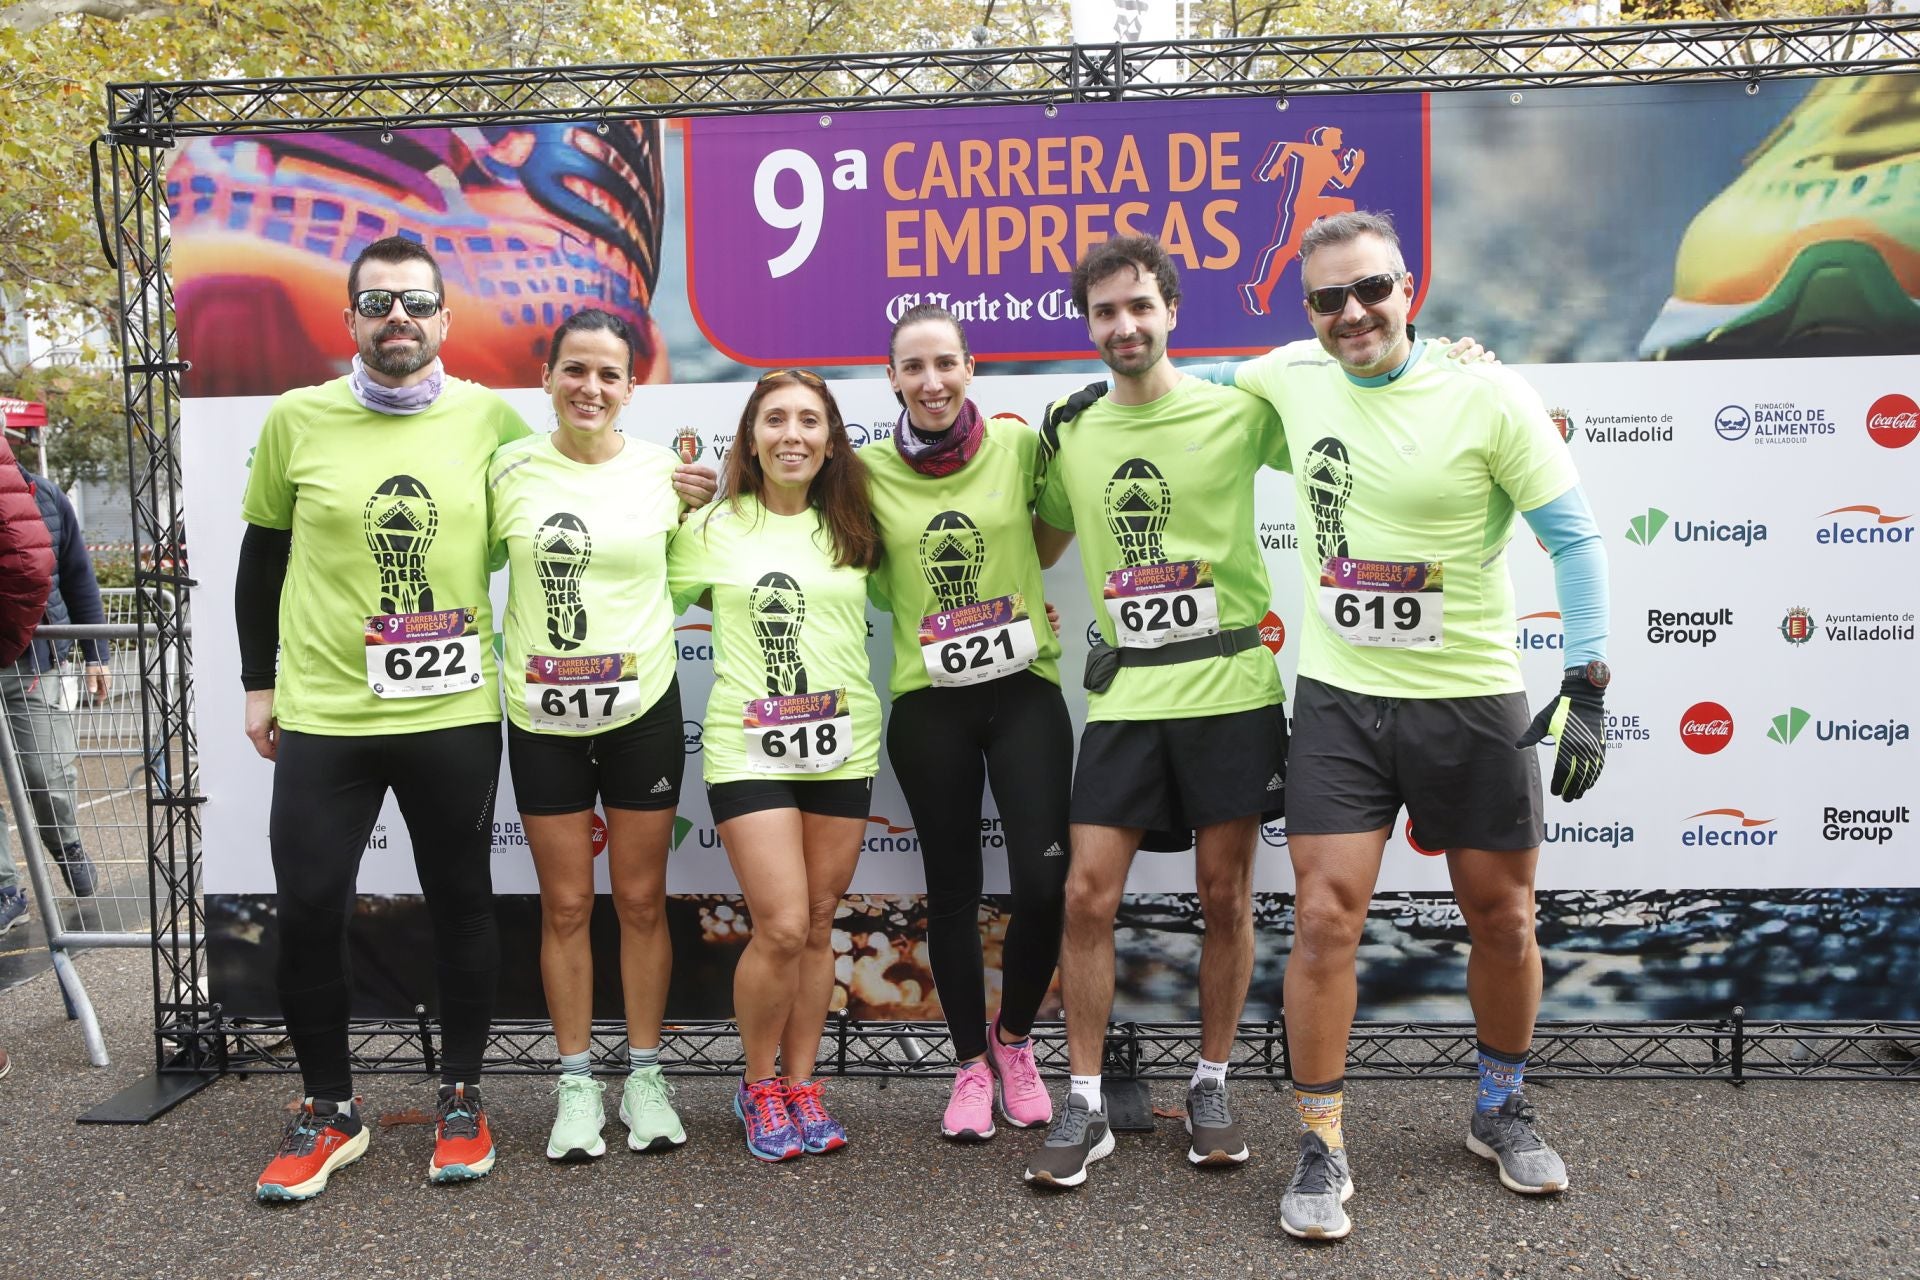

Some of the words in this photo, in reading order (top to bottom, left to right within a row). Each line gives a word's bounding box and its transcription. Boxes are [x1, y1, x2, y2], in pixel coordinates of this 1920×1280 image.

[883, 134, 1150, 201] CARRERA
[1168, 131, 1241, 192] DE
[886, 199, 1241, 277] EMPRESAS
[1004, 292, 1034, 322] de
[1585, 414, 1658, 426] Ayuntamiento
[1660, 413, 1673, 423] de
[1755, 410, 1802, 422] BANCO
[1806, 410, 1825, 420] DE
[1870, 412, 1920, 430] Coca-Cola
[1586, 426, 1673, 443] Valladolid
[1755, 423, 1836, 436] ALIMENTOS
[1323, 457, 1342, 486] MERLIN
[1113, 490, 1133, 511] LEROY
[1132, 483, 1159, 510] MERLIN
[374, 505, 398, 527] LEROY
[397, 500, 424, 530] MERLIN
[1316, 504, 1339, 520] RUN
[1318, 520, 1340, 533] NER
[1674, 520, 1767, 547] Unicaja
[1816, 522, 1914, 544] elecnor
[540, 534, 560, 551] LEROY
[560, 530, 581, 555] MERLIN
[946, 533, 973, 560] MERLIN
[1124, 532, 1160, 548] RUN
[928, 539, 950, 562] LEROY
[1127, 547, 1160, 563] NER
[383, 552, 421, 568] RUN
[1357, 562, 1390, 573] CARRERA
[1392, 563, 1402, 573] DE
[384, 568, 421, 583] NER
[1133, 567, 1164, 577] CARRERA
[1165, 565, 1175, 574] DE
[1134, 573, 1176, 585] EMPRESAS
[1357, 571, 1402, 582] EMPRESAS
[547, 579, 577, 591] RUN
[940, 581, 974, 597] RUN
[549, 592, 577, 606] NER
[756, 595, 774, 612] LEROY
[773, 590, 796, 613] MERLIN
[944, 595, 975, 611] NER
[405, 615, 438, 624] CARRERA
[951, 606, 980, 619] CARRERA
[952, 611, 992, 628] EMPRESAS
[1120, 594, 1198, 632] 620
[1335, 593, 1421, 630] 619
[1647, 607, 1733, 626] Renault
[1826, 613, 1900, 624] Ayuntamiento
[1902, 611, 1914, 622] de
[405, 621, 448, 633] EMPRESAS
[1826, 624, 1914, 641] Valladolid
[766, 637, 795, 650] RUN
[1647, 626, 1717, 647] Group
[767, 650, 796, 665] NER
[940, 628, 1015, 674] 621
[385, 642, 466, 681] 622
[558, 659, 589, 668] CARRERA
[591, 658, 600, 666] DE
[558, 665, 600, 675] EMPRESAS
[541, 687, 620, 718] 617
[779, 697, 810, 706] CARRERA
[780, 702, 820, 715] EMPRESAS
[1622, 716, 1640, 727] DE
[1683, 719, 1729, 736] Coca-Cola
[762, 724, 837, 758] 618
[1816, 720, 1909, 746] Unicaja
[650, 785, 672, 794] adidas
[1823, 806, 1909, 824] Renault
[505, 823, 521, 833] DE
[1544, 822, 1634, 848] Unicaja
[1682, 824, 1778, 846] elecnor
[1823, 824, 1893, 845] Group
